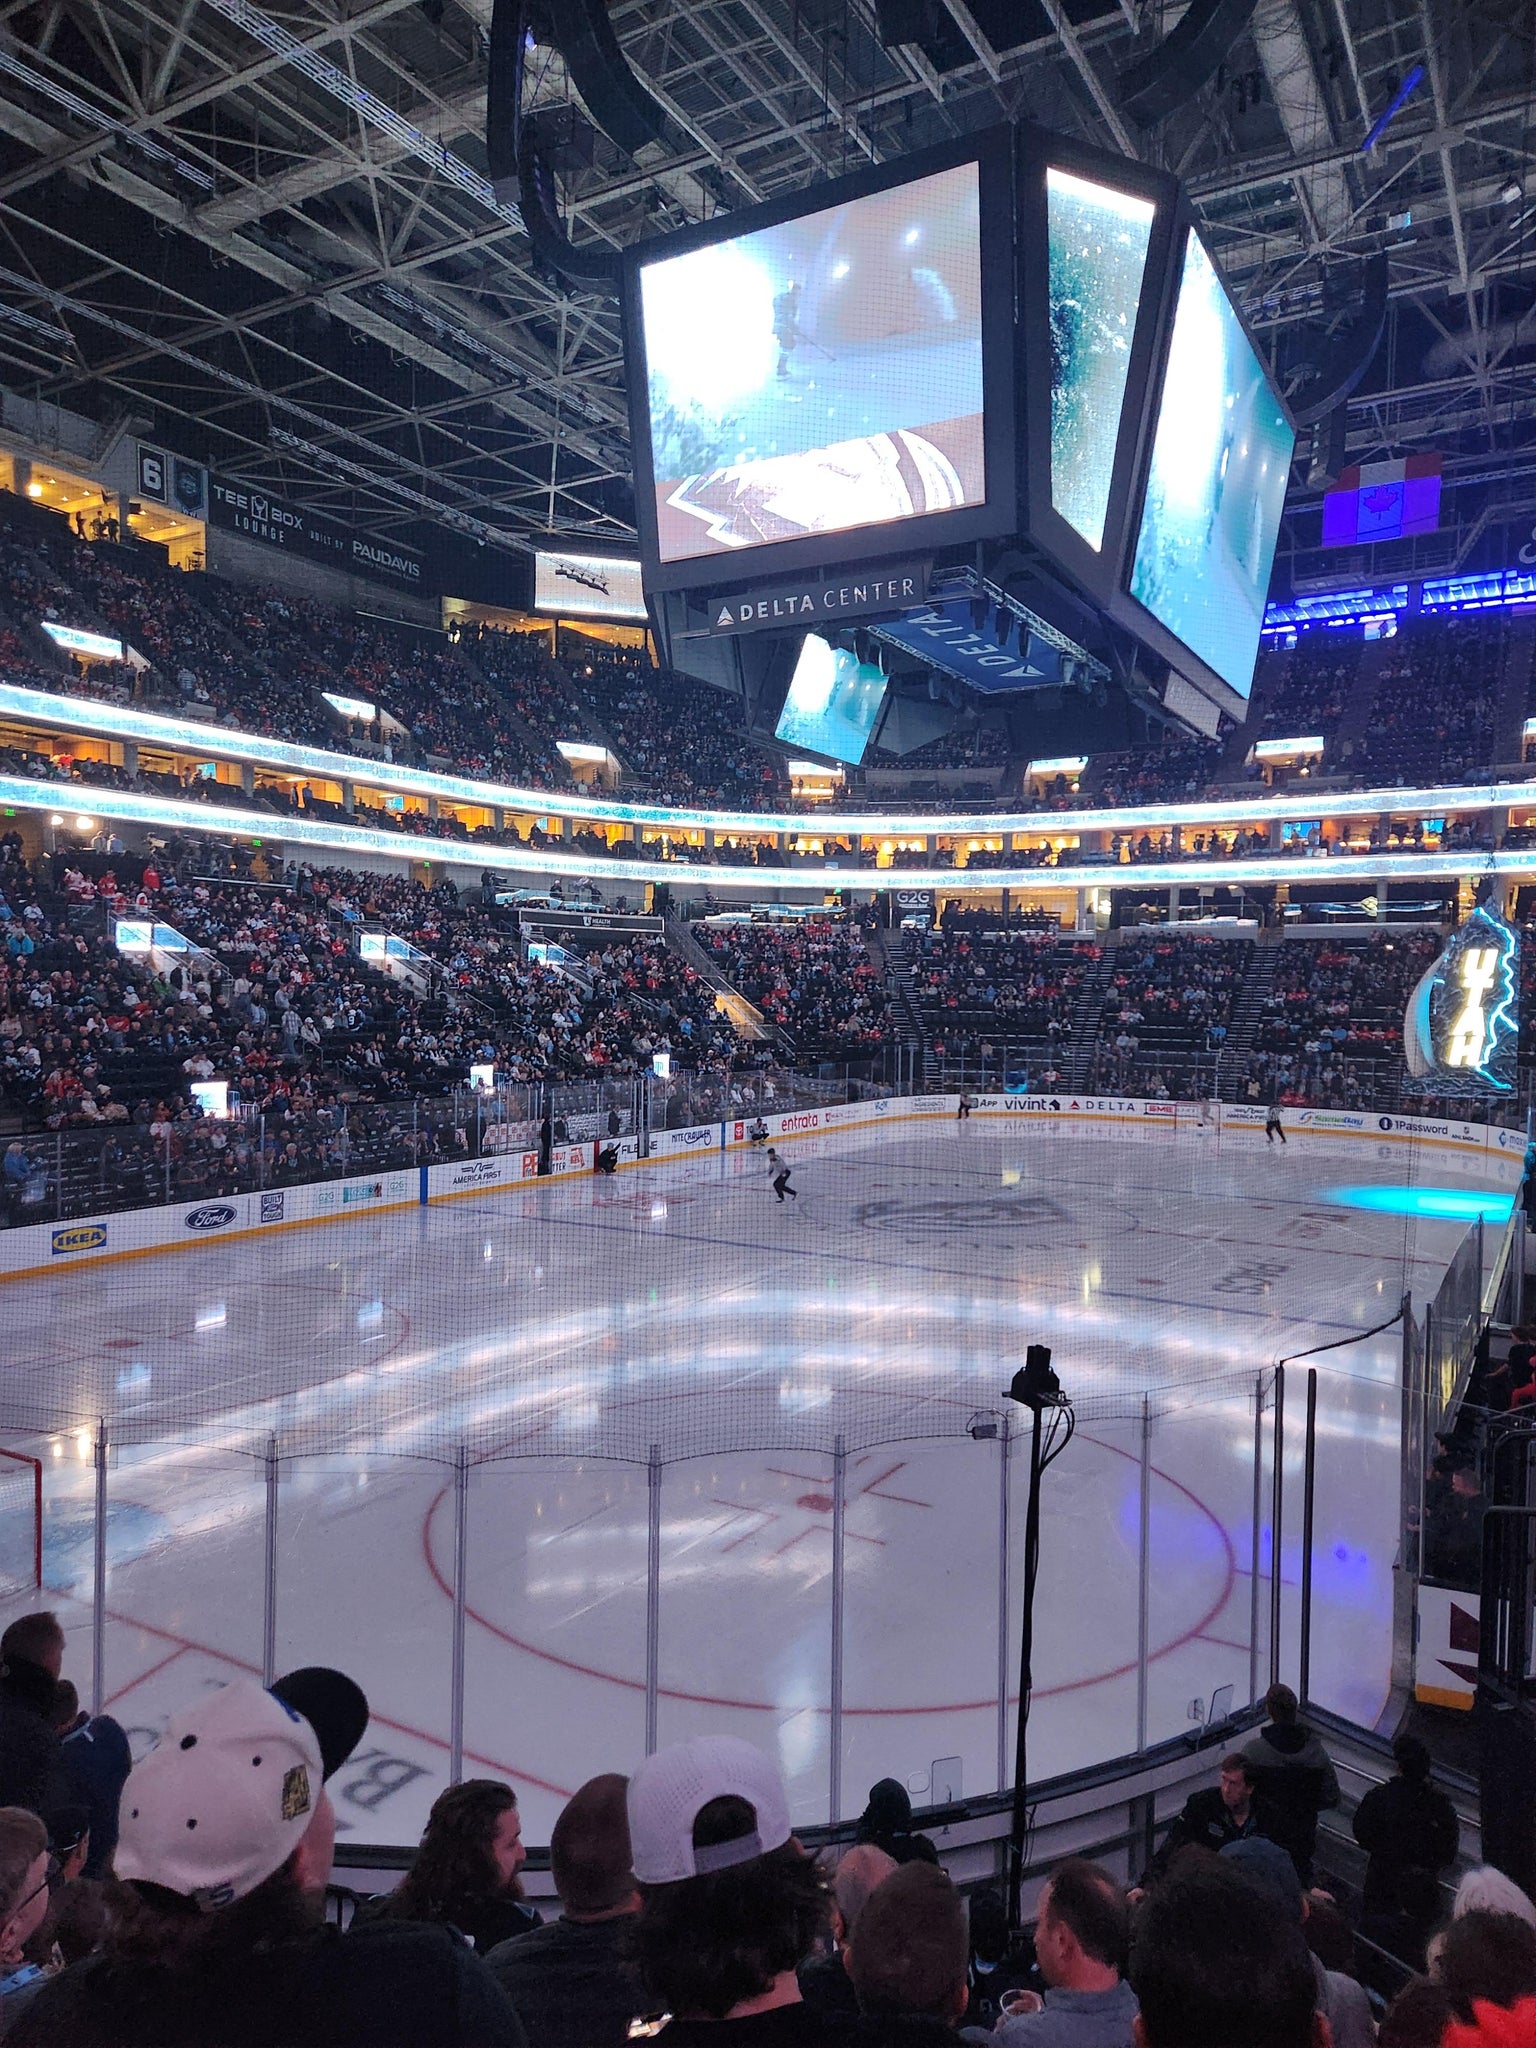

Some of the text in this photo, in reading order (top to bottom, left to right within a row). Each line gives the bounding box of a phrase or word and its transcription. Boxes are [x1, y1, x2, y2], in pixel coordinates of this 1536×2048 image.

[142, 457, 162, 490] 6
[212, 485, 304, 531] TEE BOX
[234, 513, 286, 544] LOUNGE
[740, 578, 914, 621] DELTA CENTER
[906, 611, 1017, 667] DELTA
[896, 890, 930, 904] G2G
[1447, 948, 1499, 1066] UTAH
[1004, 1096, 1047, 1111] vivint
[1086, 1100, 1136, 1112] DELTA
[781, 1113, 818, 1132] entrata
[1395, 1120, 1448, 1135] 1Password
[452, 1174, 482, 1185] AMERICA
[482, 1171, 501, 1179] FIRST
[263, 1195, 281, 1204] BUILT
[194, 1209, 228, 1227] Ford
[57, 1232, 103, 1246] IKEA
